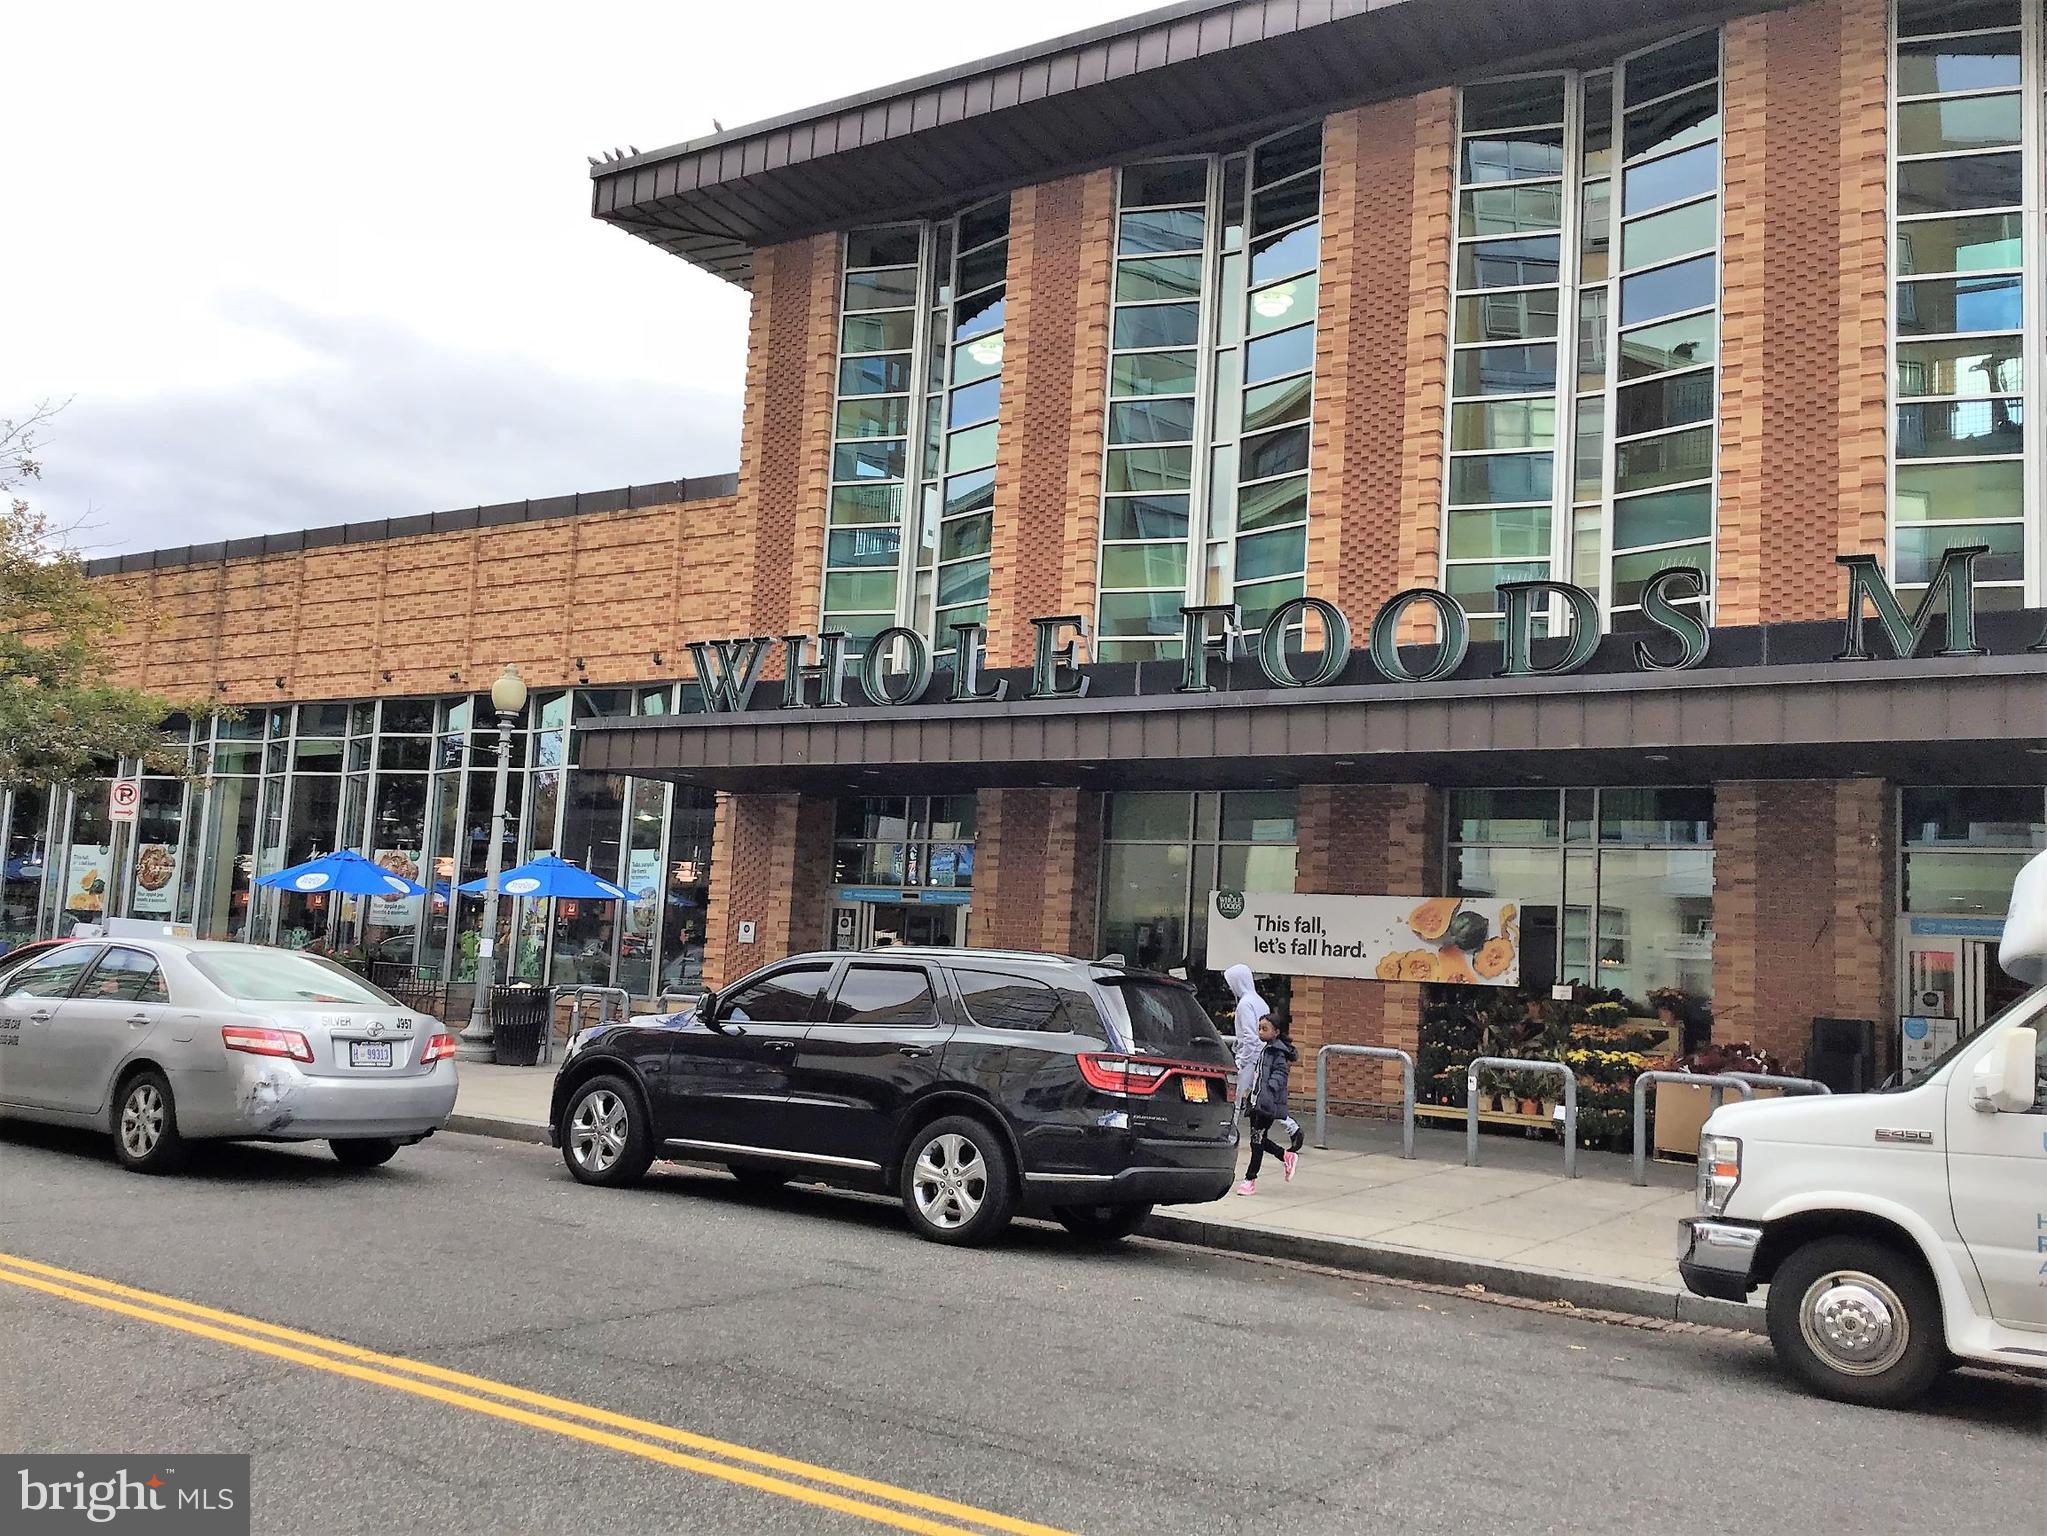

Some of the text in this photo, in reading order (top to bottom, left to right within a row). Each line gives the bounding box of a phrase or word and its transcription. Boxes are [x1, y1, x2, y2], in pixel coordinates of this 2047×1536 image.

[685, 544, 2047, 713] WHOLE FOODS M
[1254, 914, 1327, 937] This fall,
[1254, 936, 1367, 959] let's fall hard.
[321, 1016, 352, 1027] SILVER
